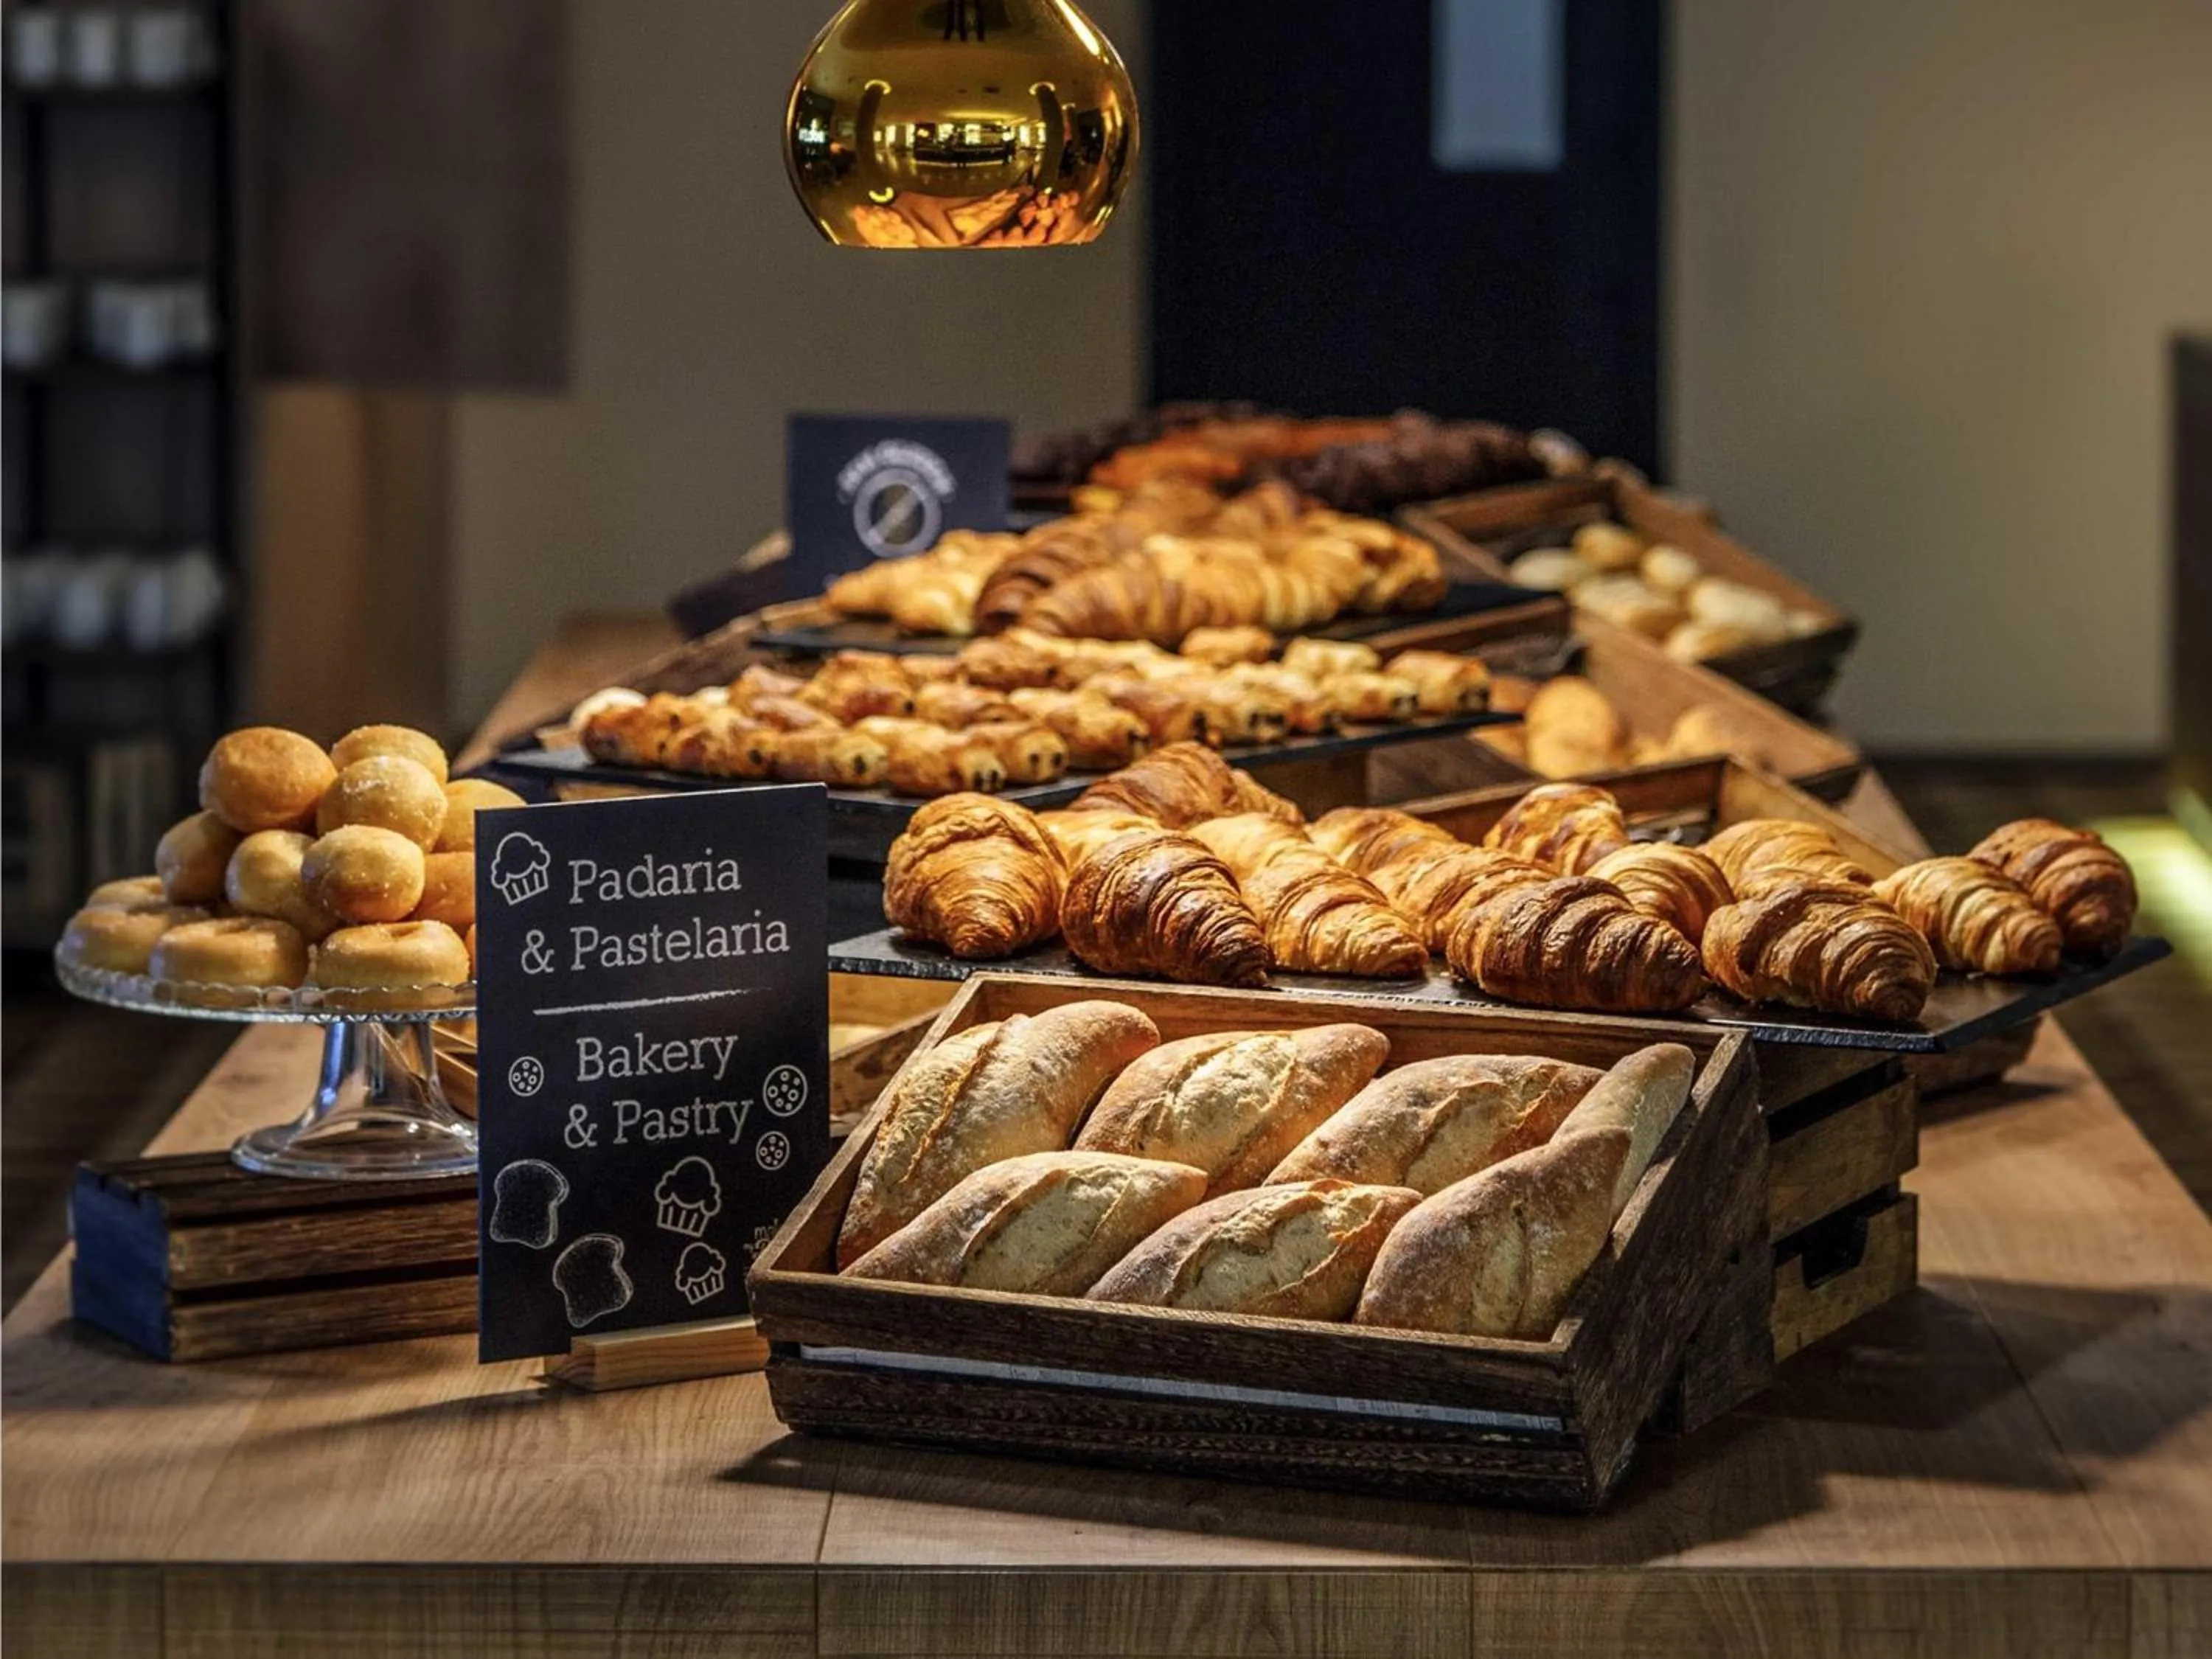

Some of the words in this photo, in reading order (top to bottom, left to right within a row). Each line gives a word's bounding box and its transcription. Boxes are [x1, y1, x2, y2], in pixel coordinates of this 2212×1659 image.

[568, 847, 742, 904] Padaria
[521, 929, 554, 975] &
[570, 909, 790, 971] Pastelaria
[576, 1032, 738, 1082] Bakery
[564, 1103, 597, 1149] &
[613, 1098, 754, 1144] Pastry
